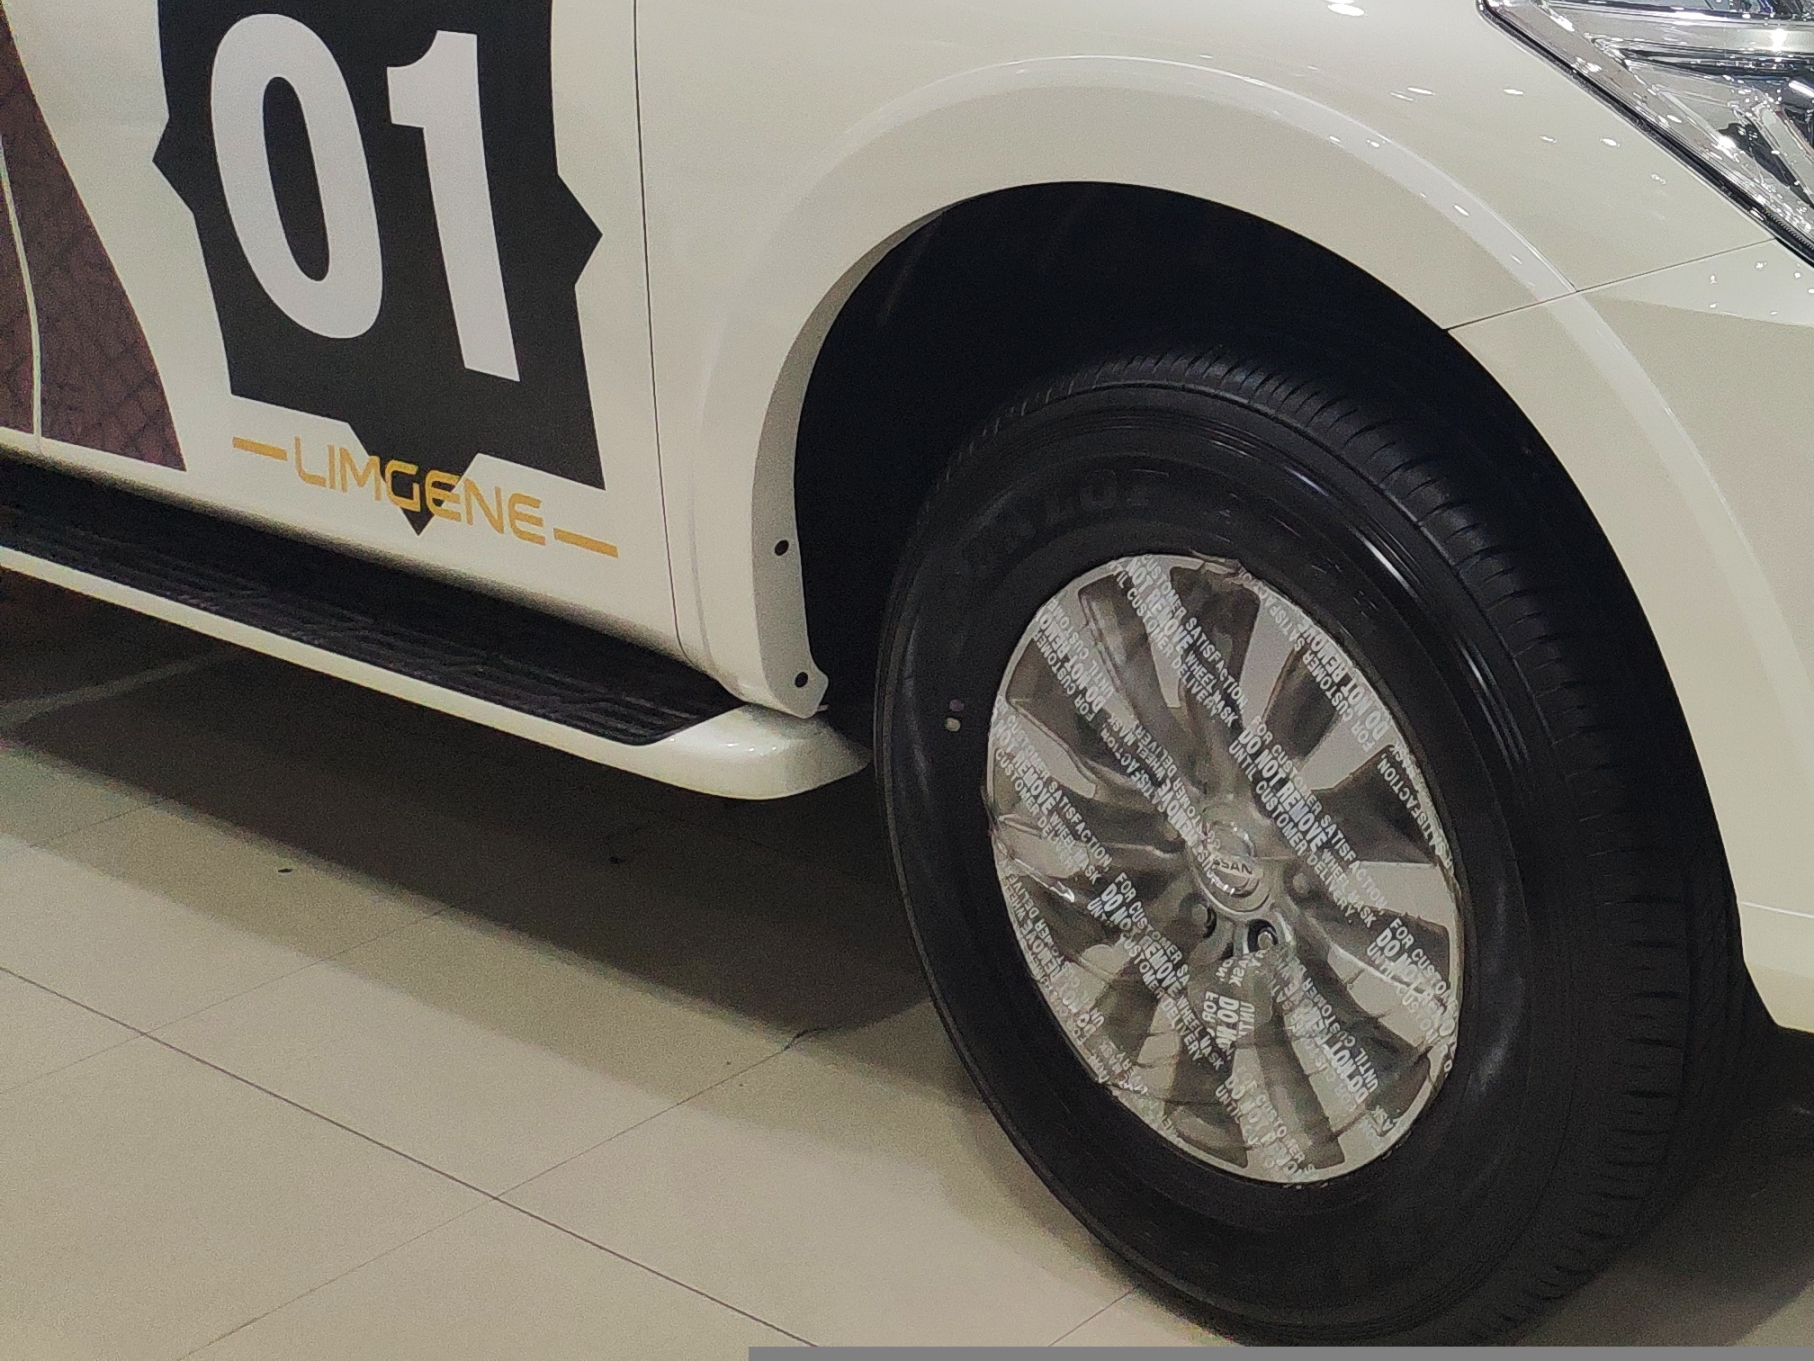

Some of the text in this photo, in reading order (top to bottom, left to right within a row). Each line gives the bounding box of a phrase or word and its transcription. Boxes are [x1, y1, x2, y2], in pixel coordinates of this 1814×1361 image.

[210, 12, 520, 383] 01
[294, 435, 546, 546] LIMGENE
[1033, 604, 1106, 713] DO NOT REMOV
[1046, 597, 1090, 660] CUSTOME
[1126, 586, 1176, 659] CUSTOMER
[1146, 588, 1192, 654] REMOVE
[1184, 651, 1218, 693] WHEEL
[1185, 617, 1250, 714] SATISFACTION,
[1302, 649, 1354, 721] CUSTOMER
[1340, 676, 1371, 715] NOT
[1073, 693, 1095, 721] FOR
[1363, 709, 1388, 740] DO
[993, 747, 1040, 817] CUSTOMER
[994, 695, 1008, 715] OR
[1046, 781, 1114, 872] SATISFACTION,
[1011, 750, 1056, 815] REMOVE
[1132, 741, 1167, 780] WHEEL
[1227, 739, 1258, 781] UNTIL
[1253, 779, 1308, 856] CUSTOMER
[1237, 726, 1377, 928] DO NOT REMOVE WHEEL MASK
[1249, 715, 1390, 916] FOR CUSTOMER SATISFACTION,
[1114, 872, 1182, 965] FOR CUSTOMER
[1375, 927, 1401, 959] DO
[1389, 917, 1414, 949] FOR
[1099, 882, 1124, 914] DO
[1137, 933, 1183, 999] REMOVE
[1175, 994, 1204, 1039] WHEEL
[1198, 1034, 1224, 1071] MASK
[1301, 975, 1355, 1051] CUSTOMER
[1325, 1036, 1355, 1079] NOT
[1347, 1072, 1369, 1103] DO
[1350, 1046, 1382, 1091] UNTIL
